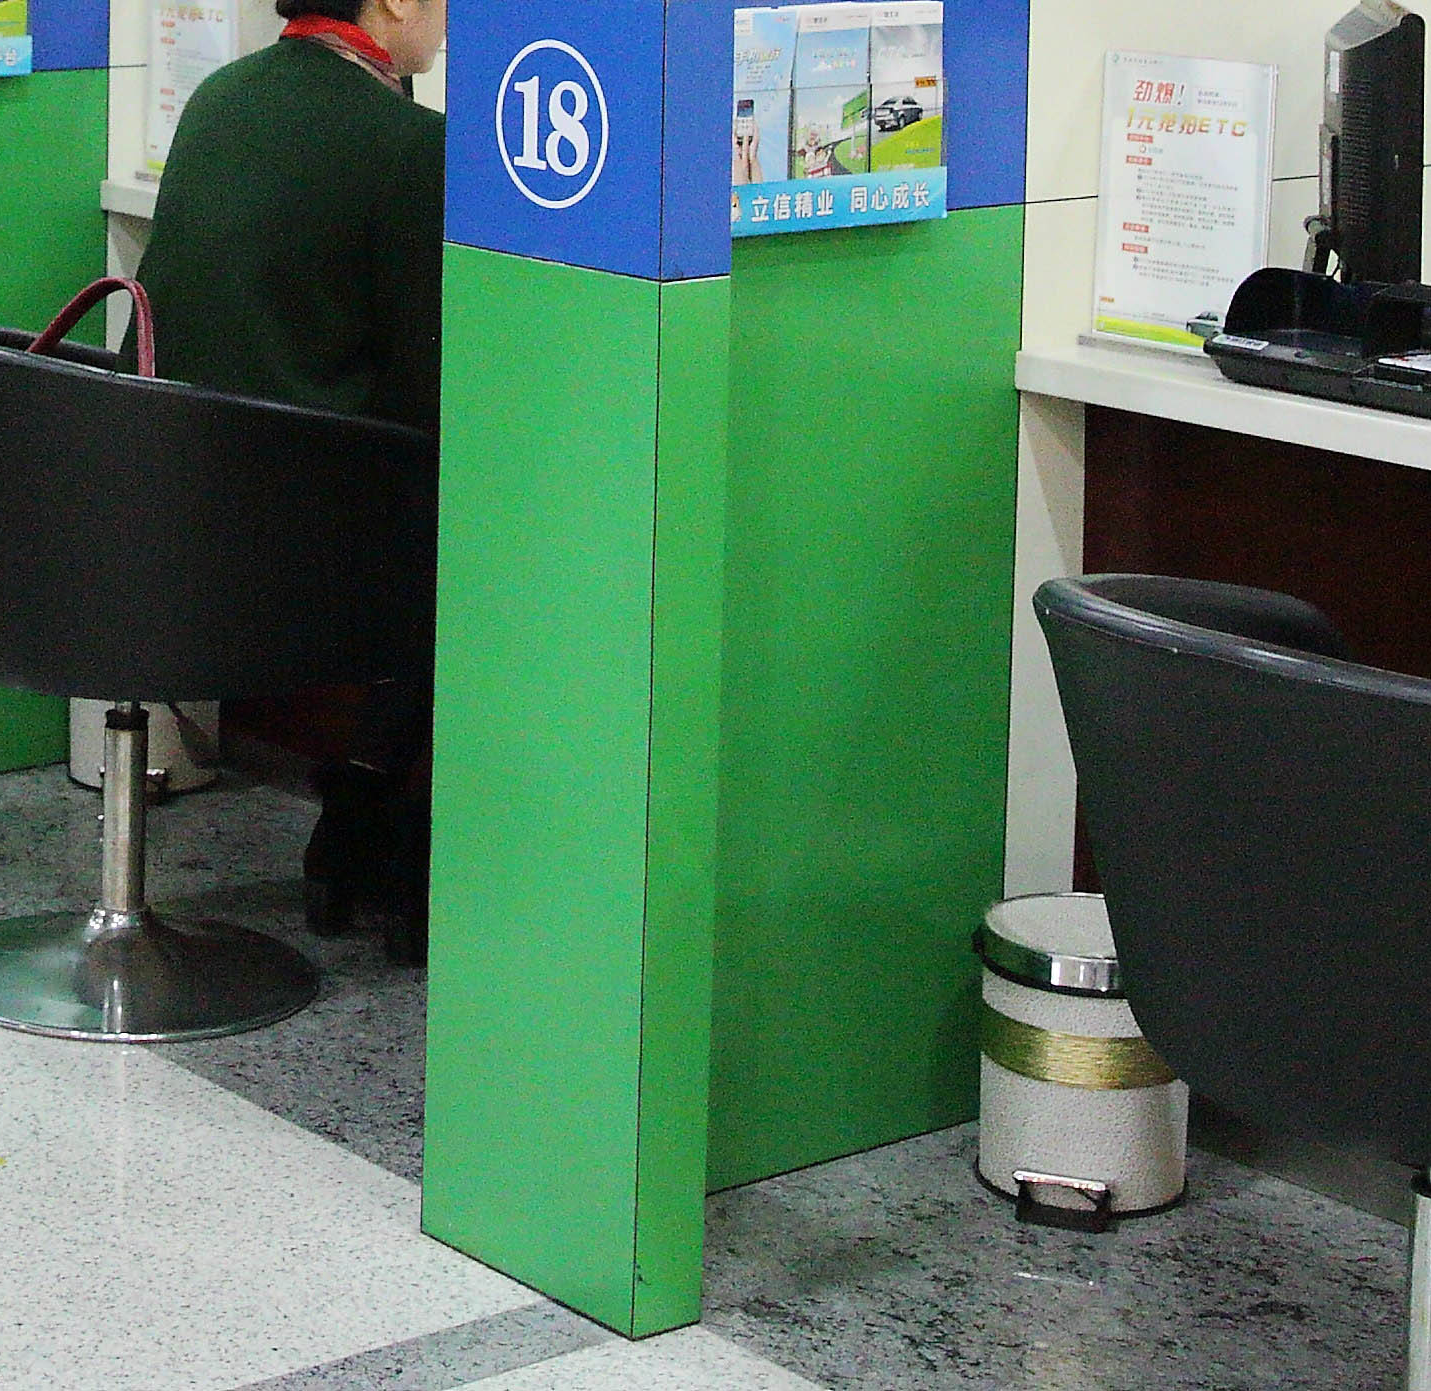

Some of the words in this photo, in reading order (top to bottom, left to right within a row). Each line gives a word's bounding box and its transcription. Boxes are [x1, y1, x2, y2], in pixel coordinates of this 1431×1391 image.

[513, 75, 590, 177] 18
[751, 189, 835, 223] 立信精业
[850, 181, 931, 214] 同心成长
